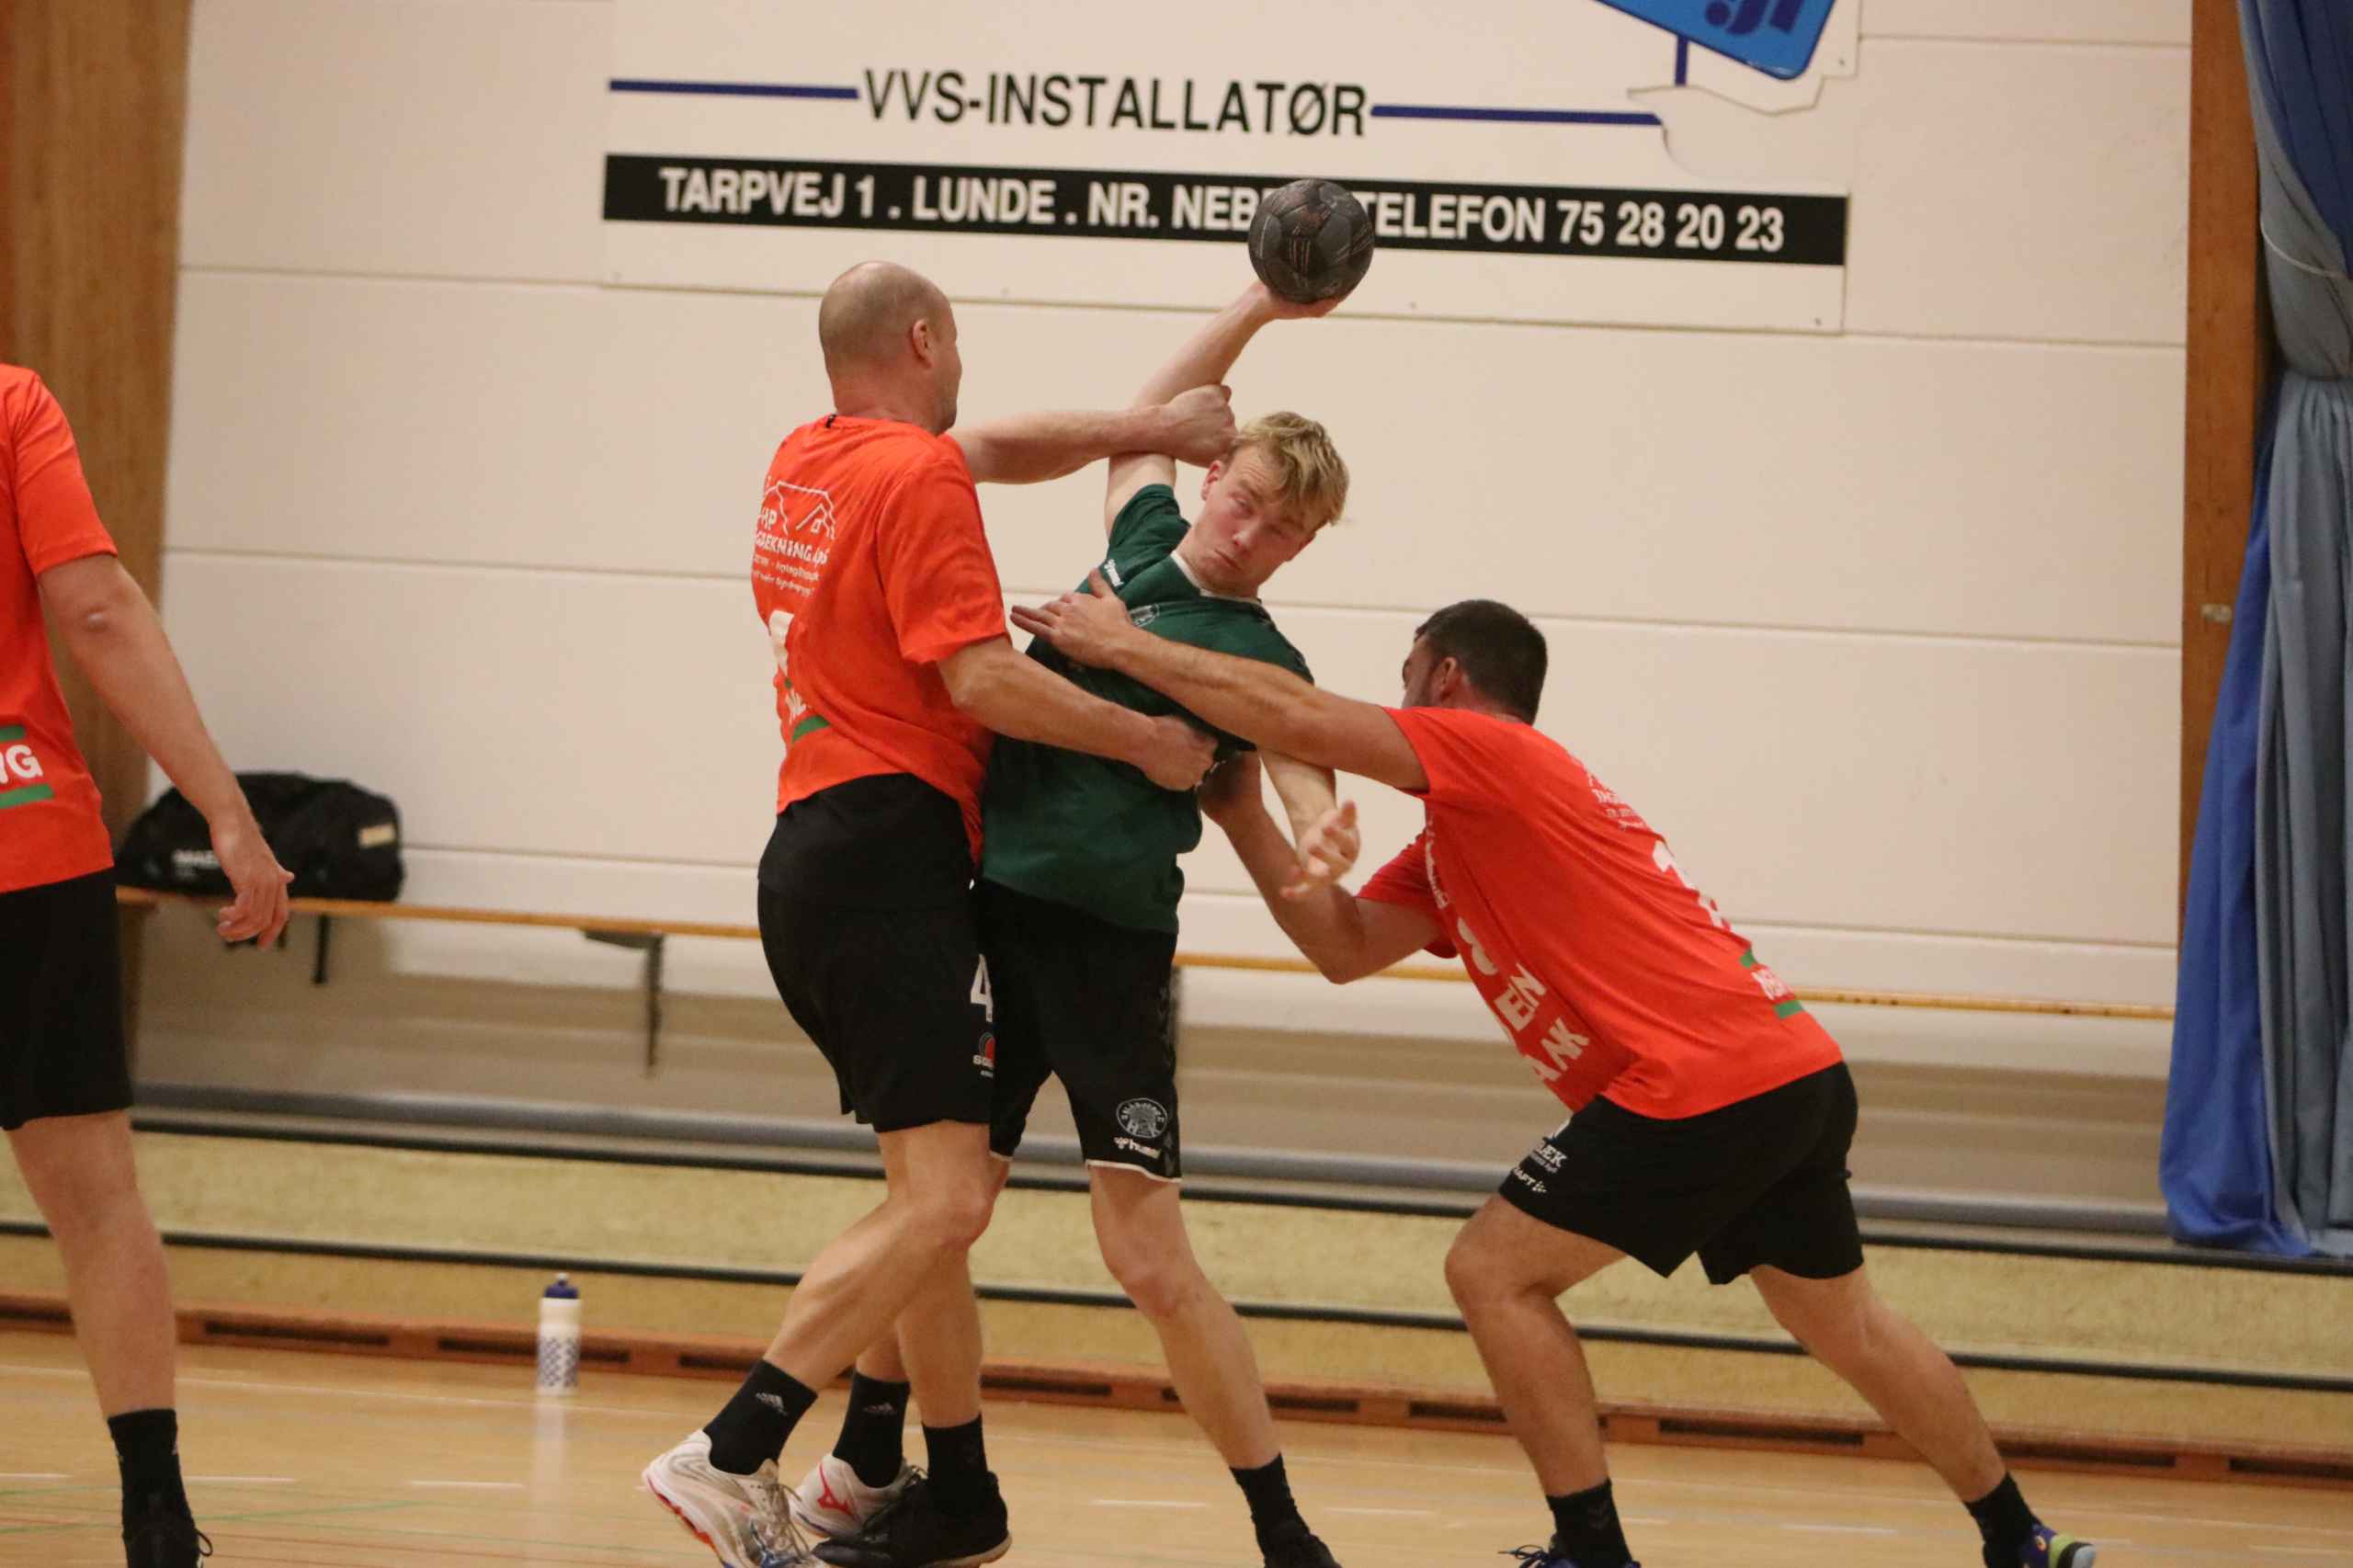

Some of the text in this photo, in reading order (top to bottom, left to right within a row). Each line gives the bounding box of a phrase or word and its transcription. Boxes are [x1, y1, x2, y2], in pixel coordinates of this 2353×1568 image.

[864, 70, 1367, 137] VVS-INSTALLATØR
[658, 166, 847, 219] TARPVEJ
[913, 175, 1056, 224] LUNDE
[1087, 180, 1160, 228] NR.
[1171, 184, 1270, 231] NEB
[1556, 199, 1606, 246] 75
[1615, 200, 1665, 247] 28
[1674, 202, 1725, 251] 20
[1734, 205, 1785, 253] 23
